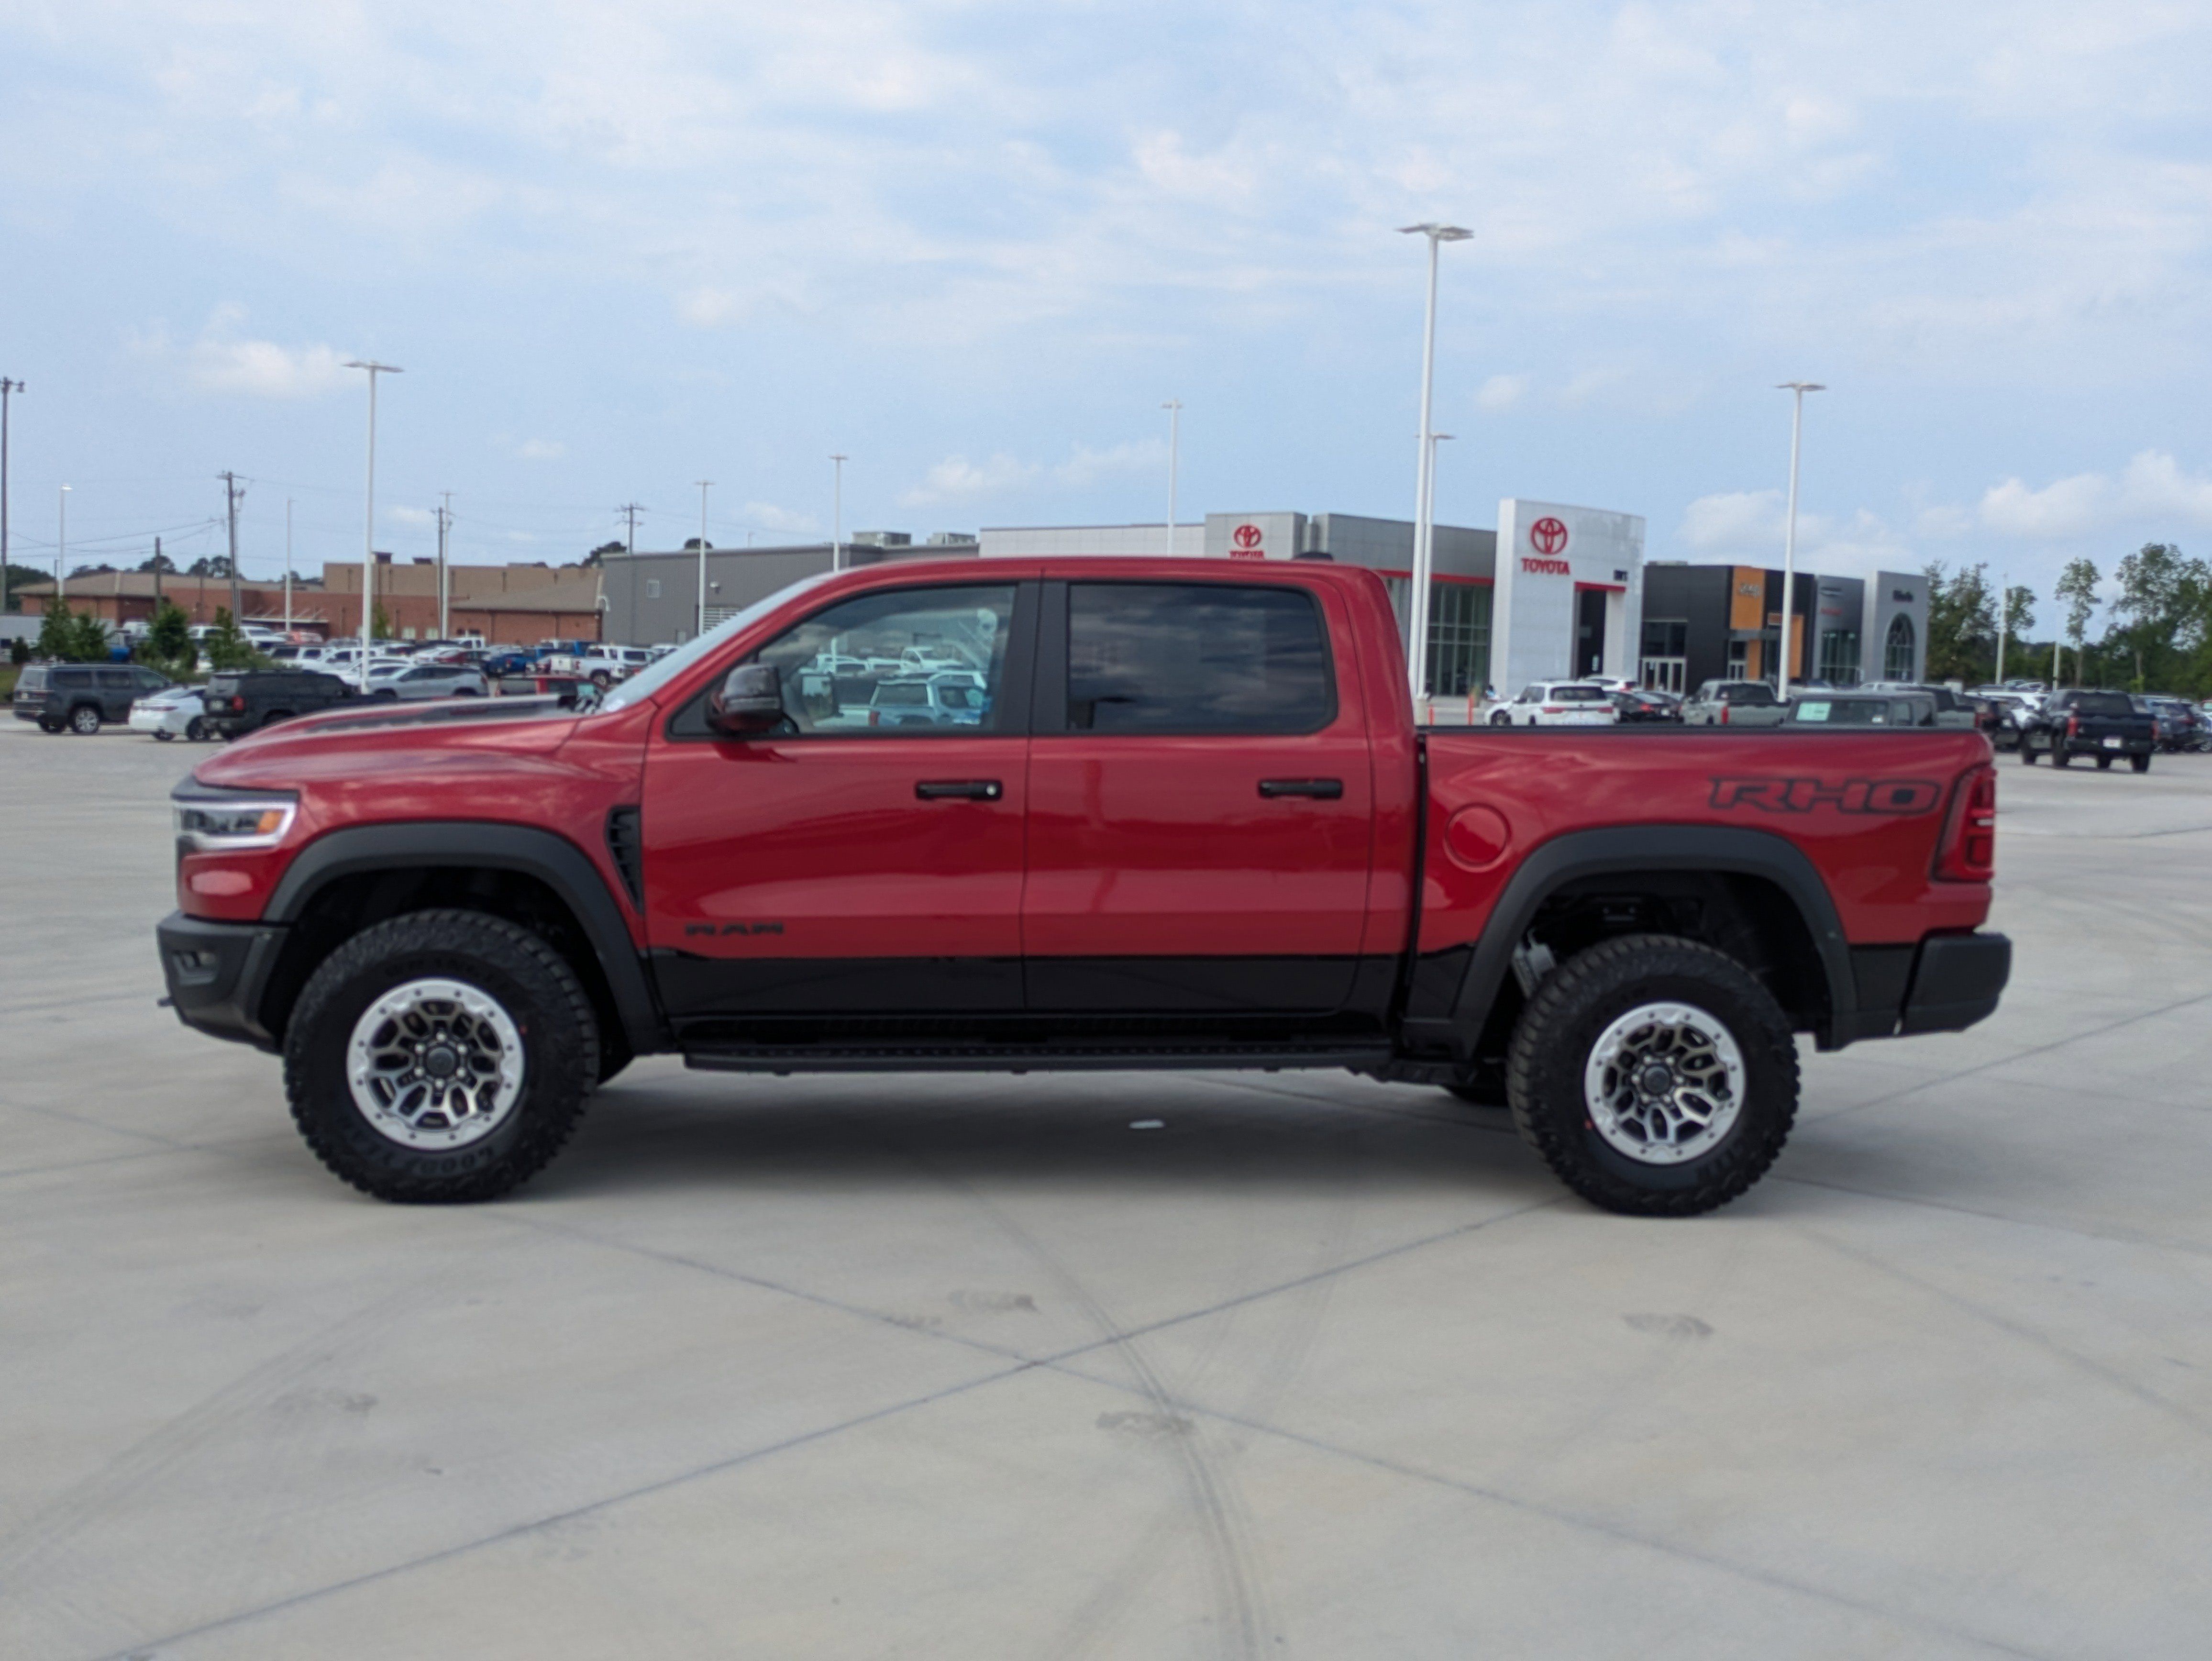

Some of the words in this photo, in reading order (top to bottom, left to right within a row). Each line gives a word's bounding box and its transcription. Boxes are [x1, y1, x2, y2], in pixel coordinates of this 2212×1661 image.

[1521, 558, 1571, 575] TOYOTA
[1709, 777, 1940, 814] RHO
[686, 923, 783, 935] RAM
